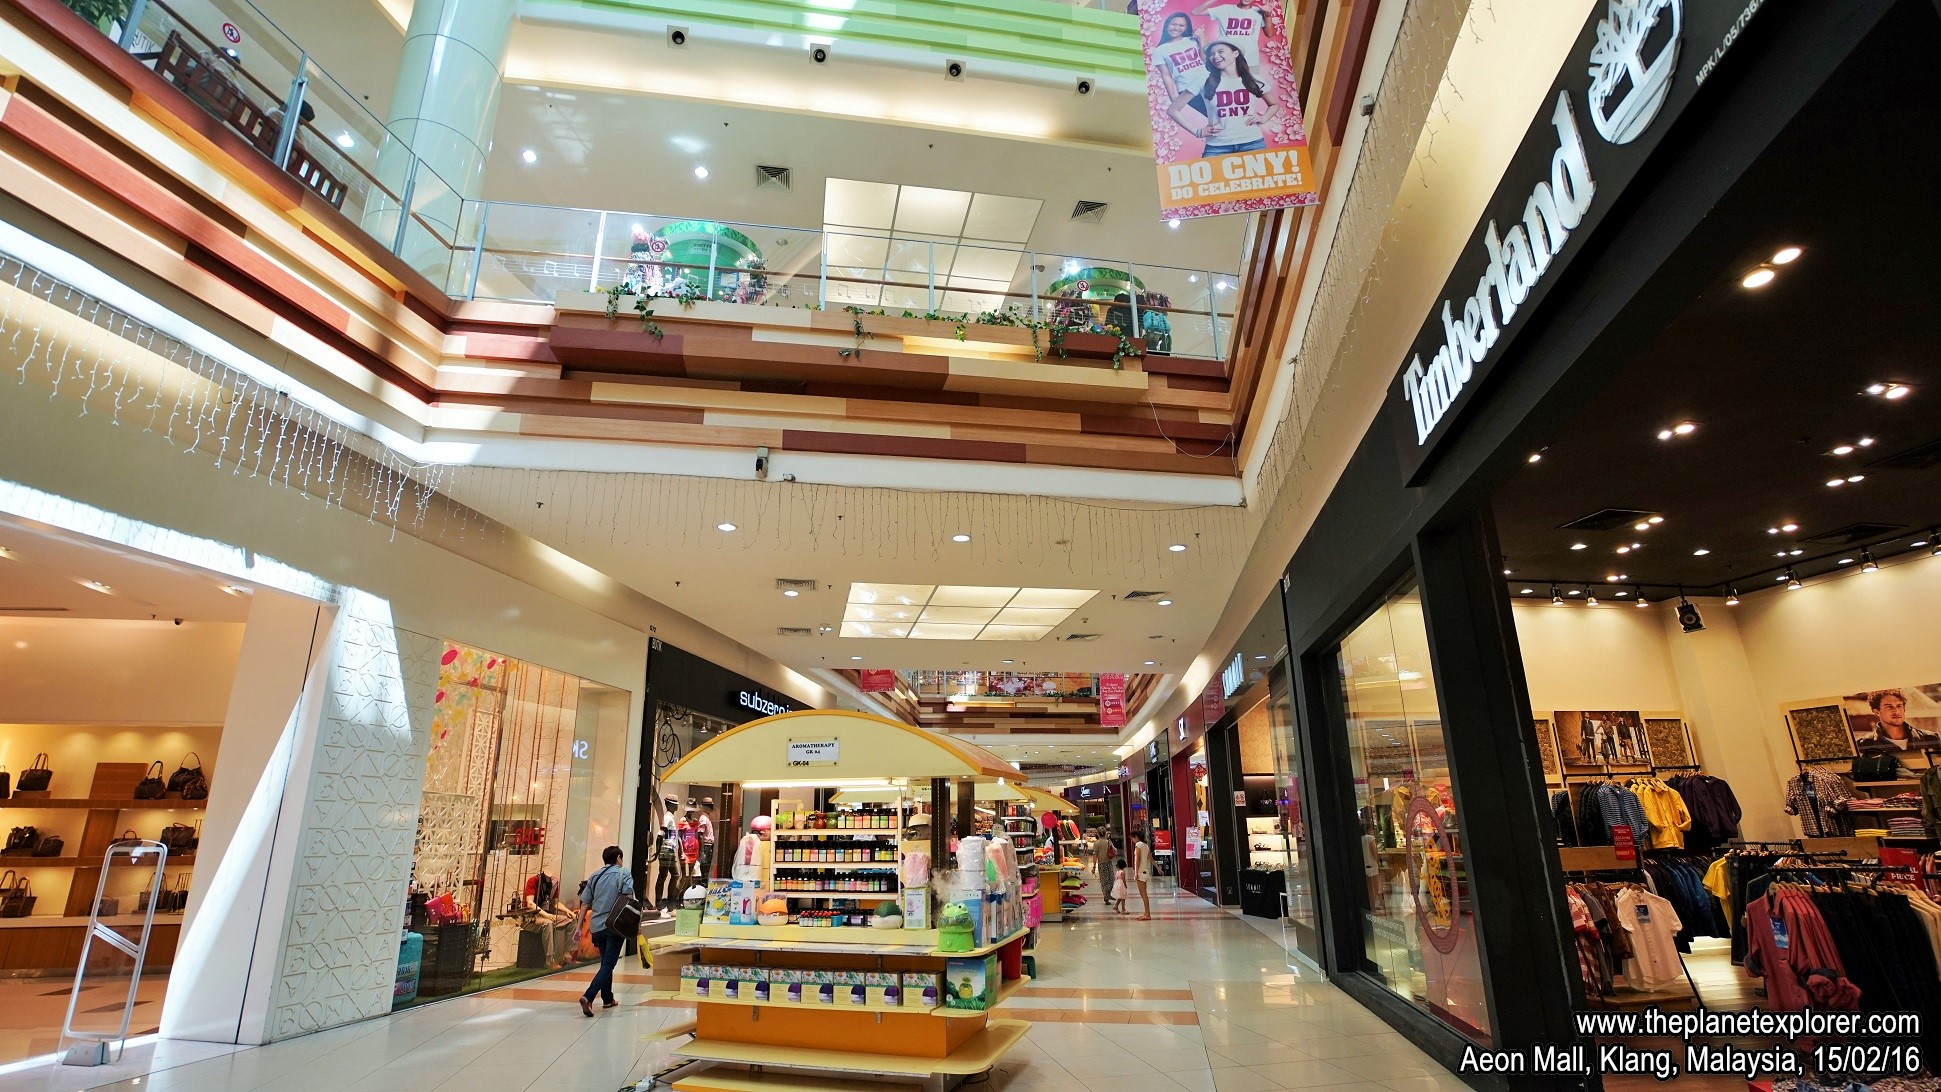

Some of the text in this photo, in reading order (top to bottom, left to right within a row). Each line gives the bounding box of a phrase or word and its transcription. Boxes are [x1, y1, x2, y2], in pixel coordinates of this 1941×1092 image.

[1227, 18, 1252, 30] DO
[1169, 47, 1199, 67] DO
[1177, 60, 1202, 74] LUCK
[1216, 89, 1250, 107] DO
[1217, 106, 1250, 118] CNY
[1168, 150, 1300, 188] DO CNY!
[1171, 186, 1193, 200] DO
[1198, 172, 1303, 197] CELEBRATE!
[1403, 90, 1597, 446] Timberland
[514, 827, 545, 846] SALE
